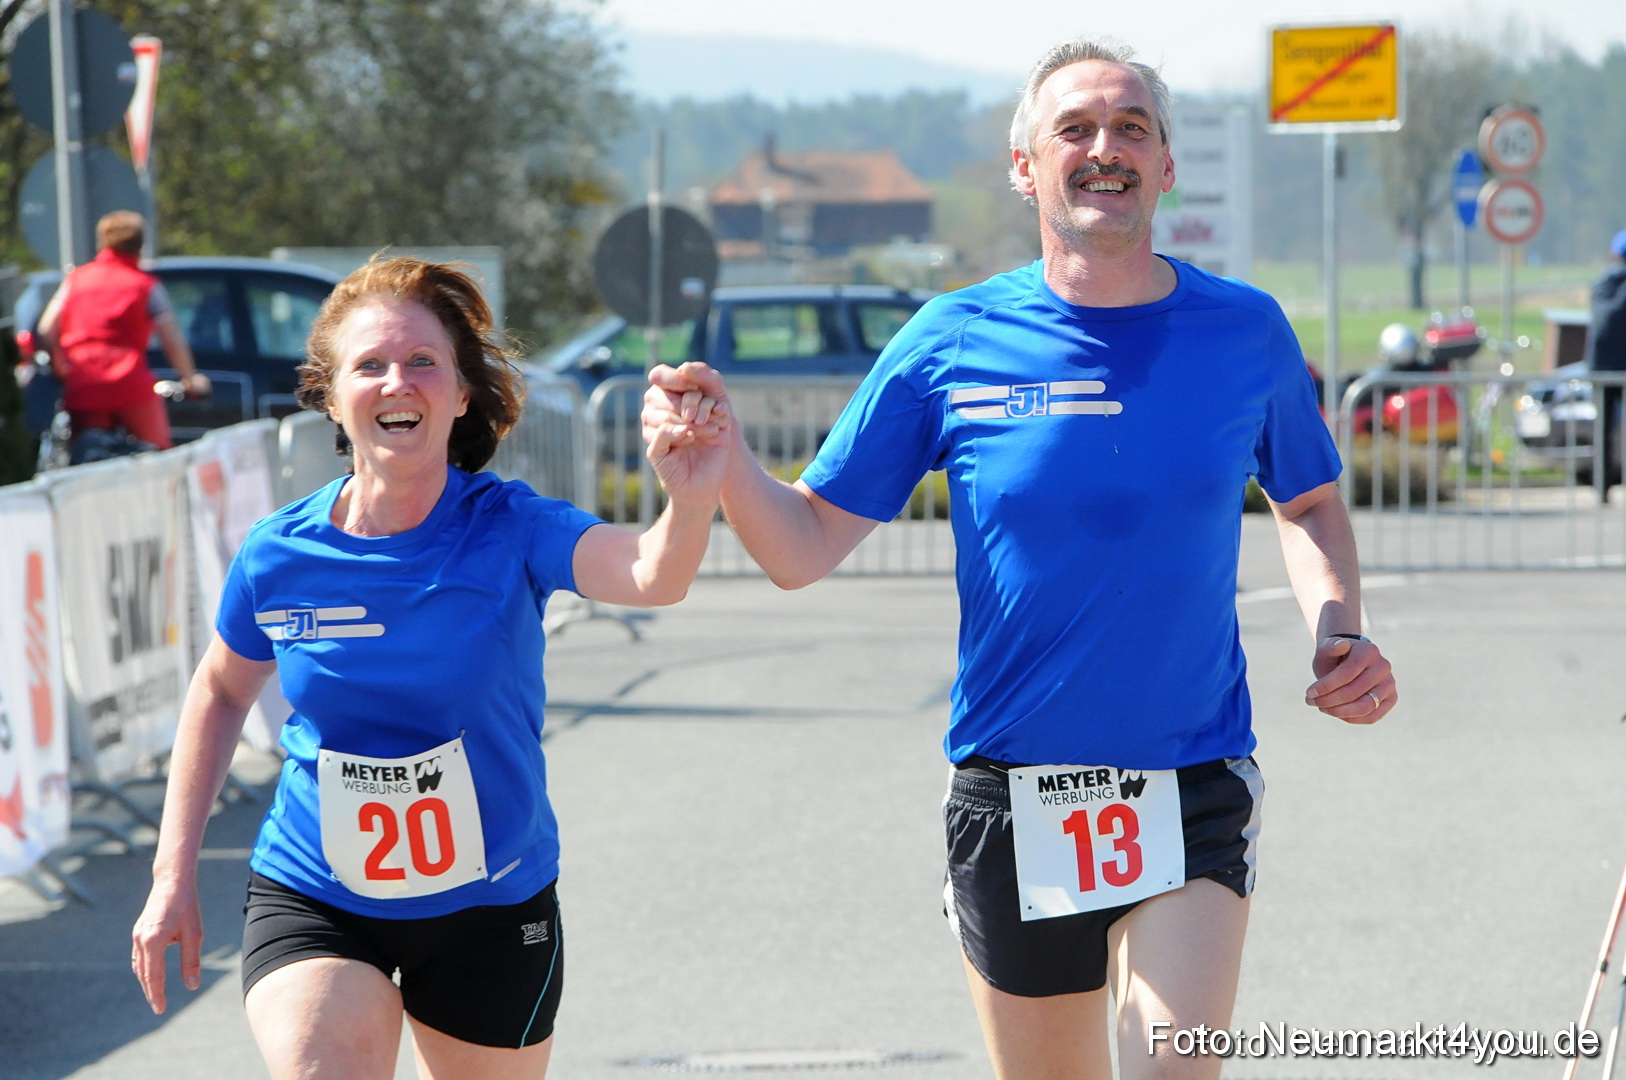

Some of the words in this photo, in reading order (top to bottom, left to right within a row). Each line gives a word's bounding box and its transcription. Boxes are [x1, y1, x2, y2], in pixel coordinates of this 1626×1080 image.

[342, 761, 409, 782] MEYER
[1038, 768, 1113, 793] MEYER
[342, 779, 412, 795] WERBUNG
[1039, 787, 1115, 807] WERBUNG
[358, 797, 456, 881] 20
[1062, 803, 1143, 893] 13
